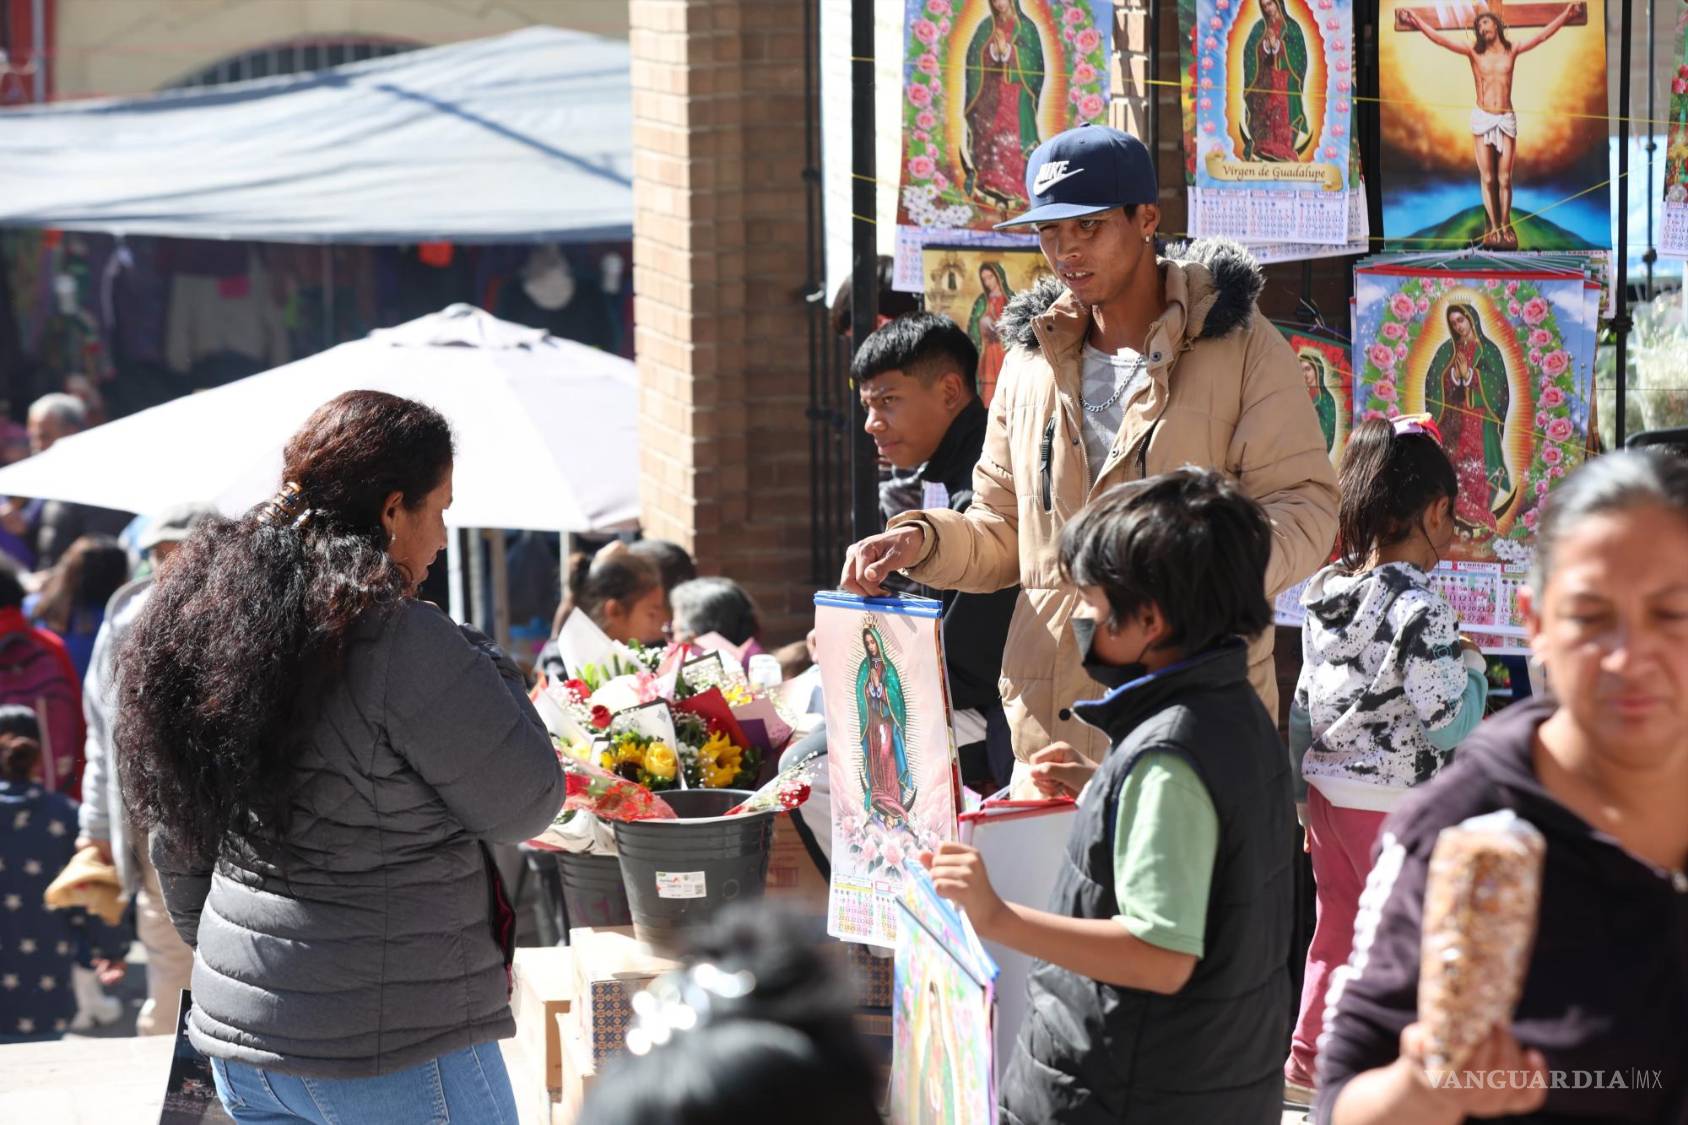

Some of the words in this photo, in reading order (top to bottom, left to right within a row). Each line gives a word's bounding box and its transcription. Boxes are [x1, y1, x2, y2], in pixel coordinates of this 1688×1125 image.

[1039, 160, 1070, 182] NIKE
[1223, 165, 1255, 181] Virgen
[1258, 165, 1269, 177] de
[1272, 165, 1326, 182] Guadalupe
